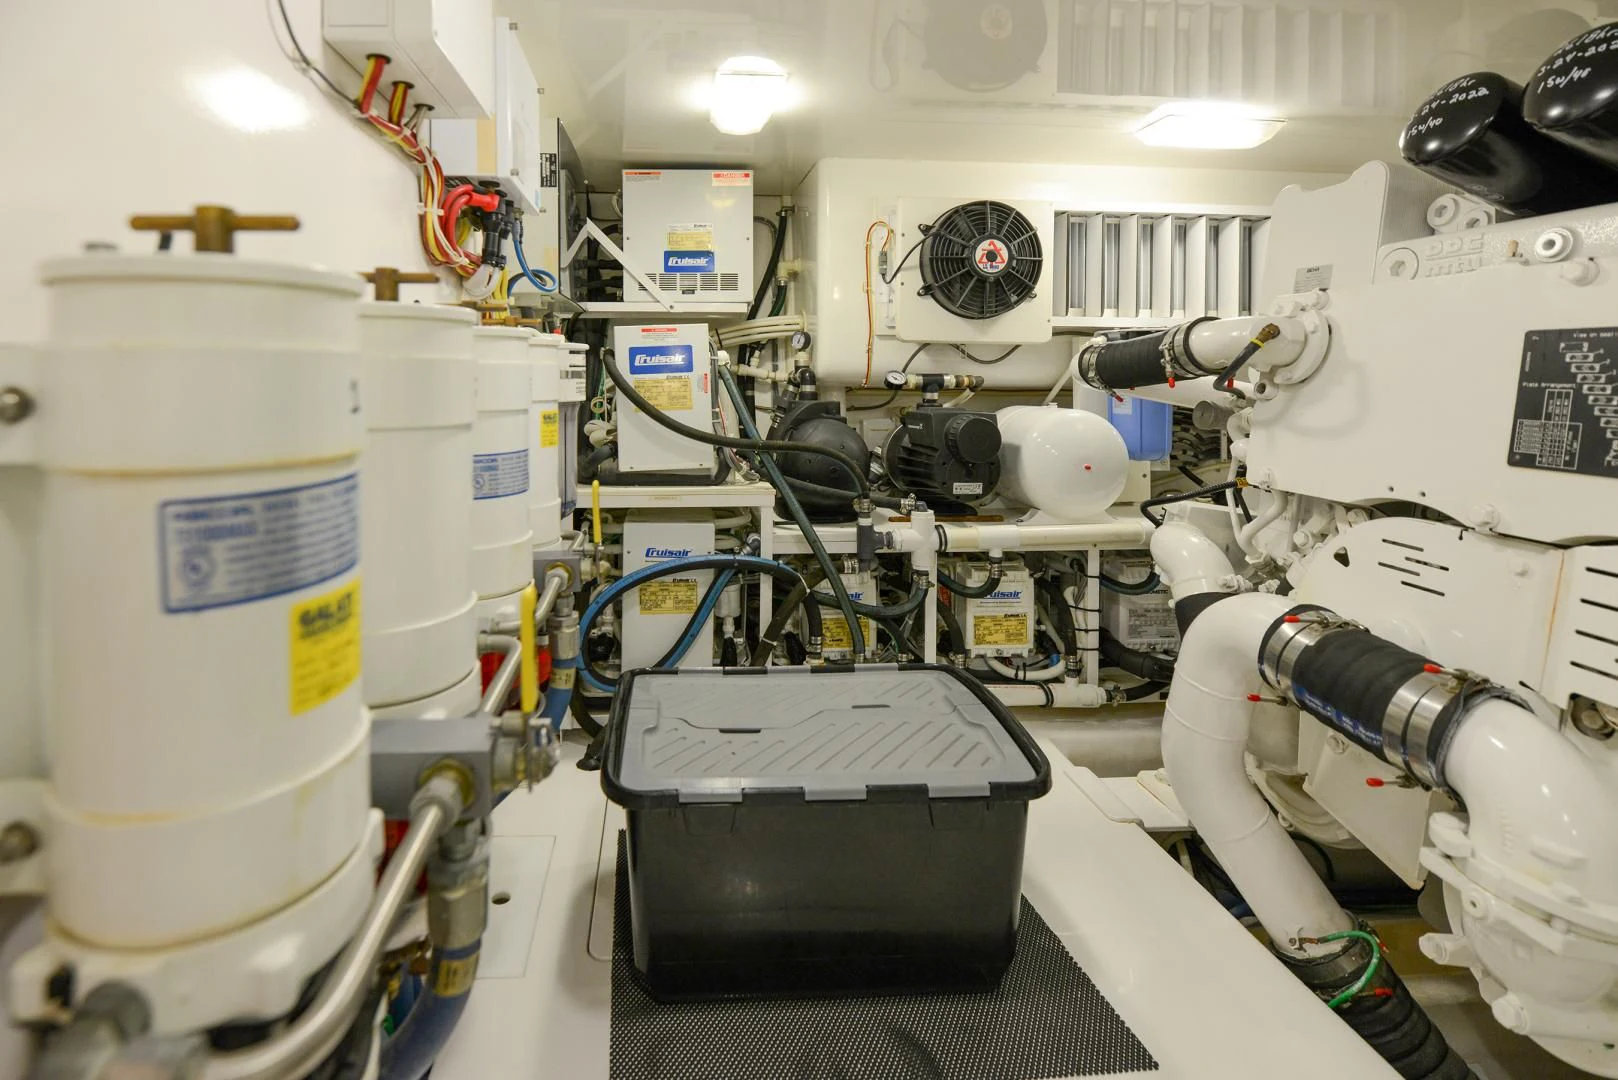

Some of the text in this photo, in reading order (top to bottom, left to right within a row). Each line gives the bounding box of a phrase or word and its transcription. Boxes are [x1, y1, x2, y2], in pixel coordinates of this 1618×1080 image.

[668, 256, 710, 266] Cruisair
[634, 354, 686, 366] Cruisair
[645, 547, 692, 558] Cruisair
